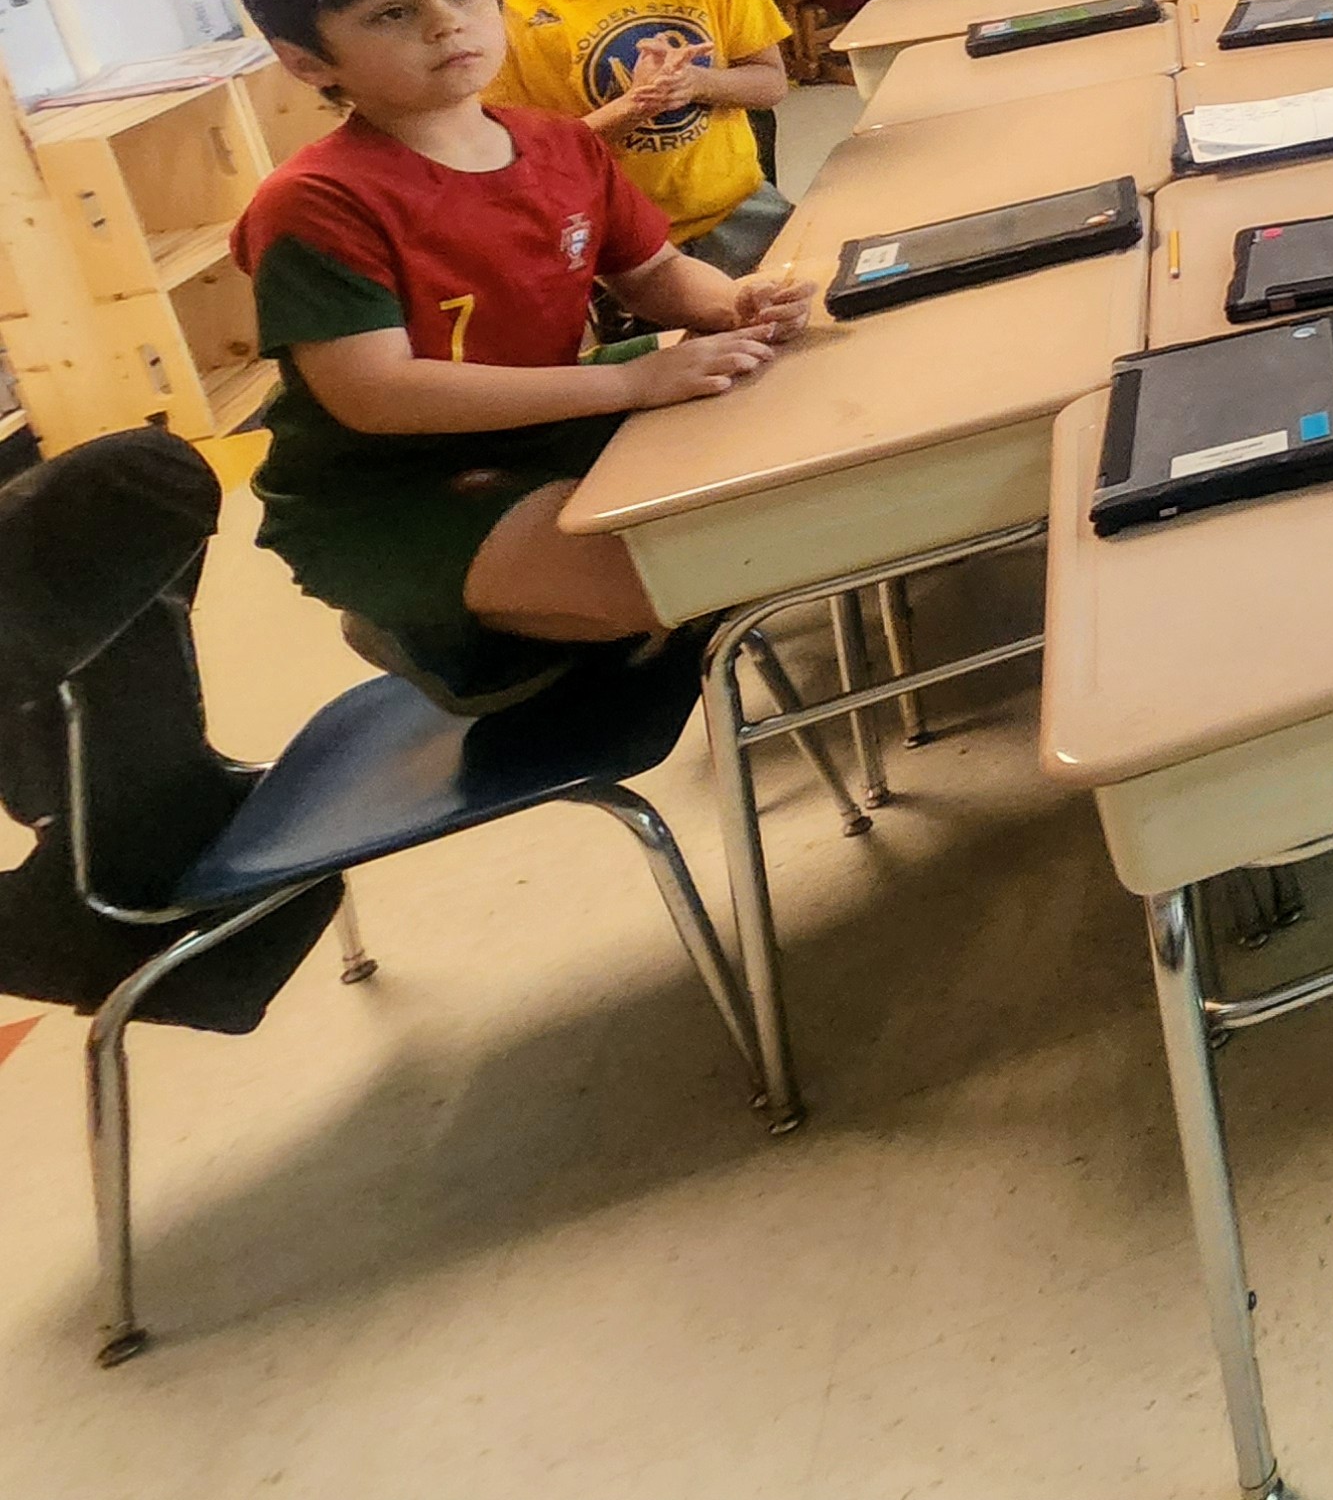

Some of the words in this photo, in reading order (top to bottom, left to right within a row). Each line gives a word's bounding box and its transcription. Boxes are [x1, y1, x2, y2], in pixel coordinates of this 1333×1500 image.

[646, 3, 708, 24] STATE
[622, 111, 710, 153] WARRIO
[439, 293, 476, 362] 7
